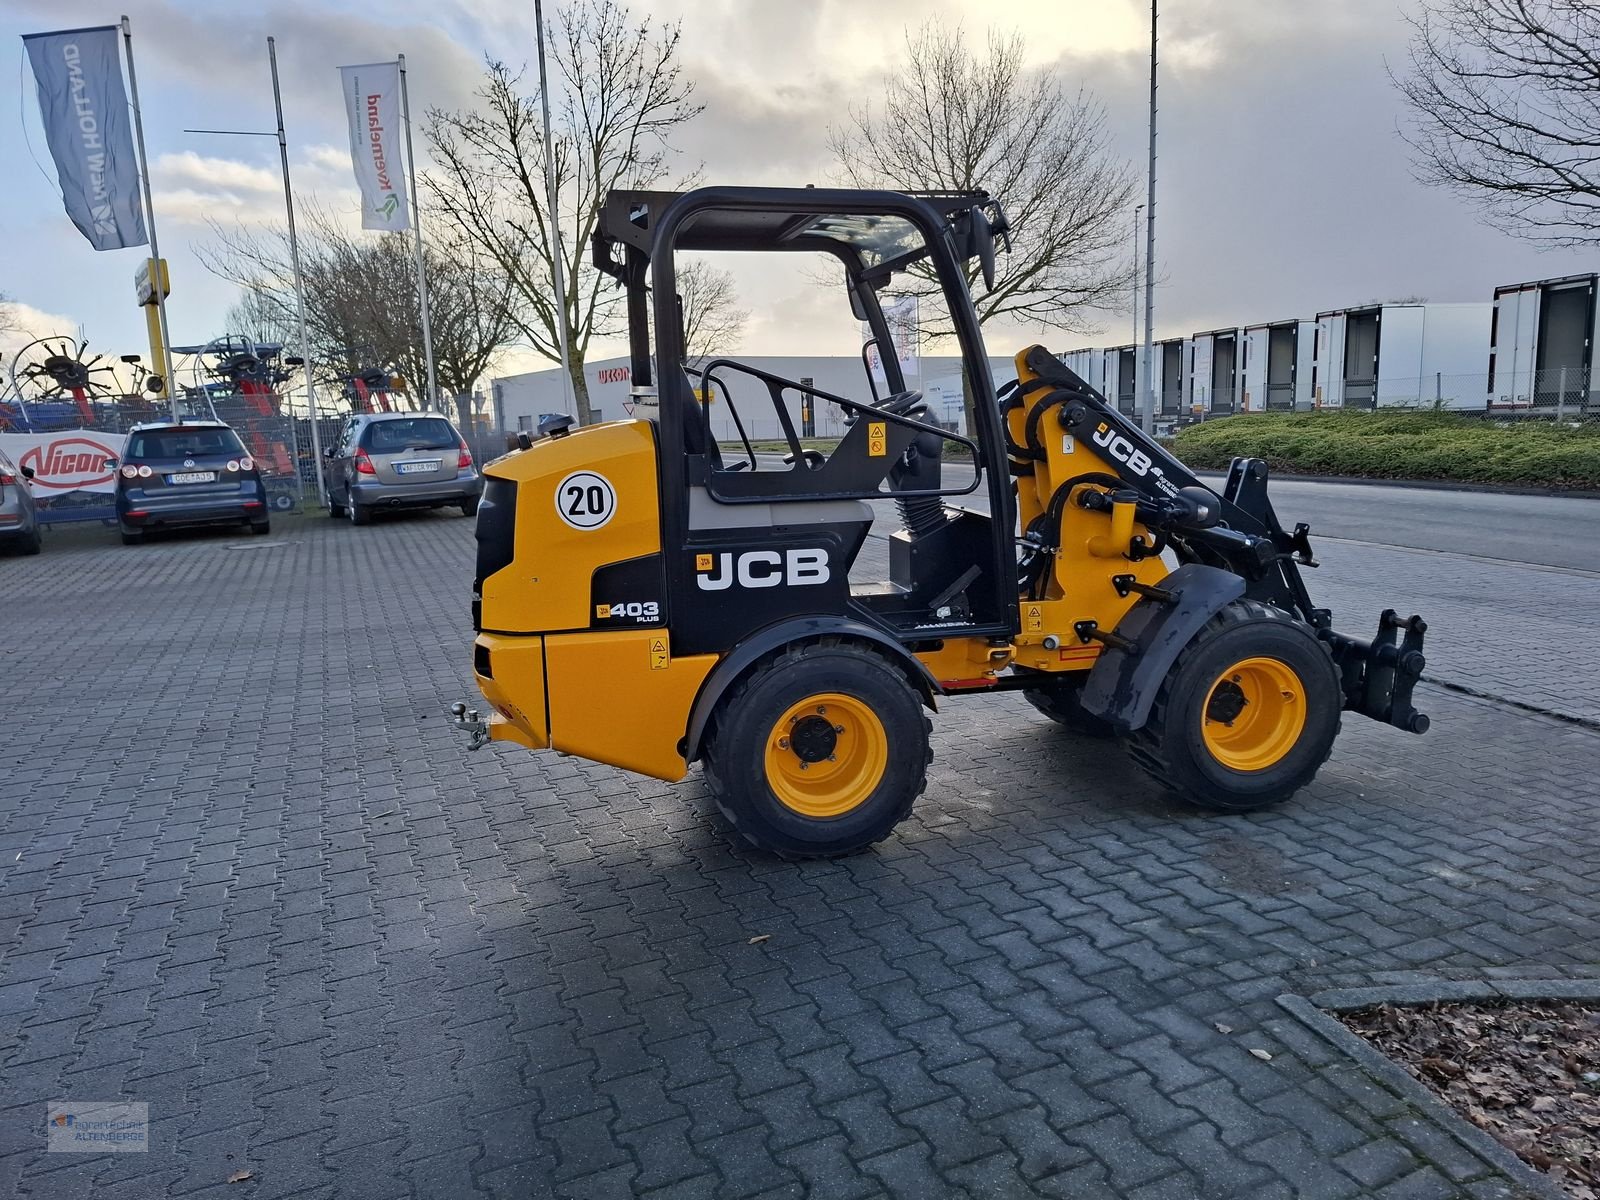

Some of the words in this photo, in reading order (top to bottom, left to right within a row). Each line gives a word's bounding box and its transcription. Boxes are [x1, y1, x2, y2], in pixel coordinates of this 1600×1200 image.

[36, 446, 107, 476] Vicon
[1092, 429, 1152, 476] JCB
[1159, 475, 1180, 493] agrartec
[567, 485, 604, 515] 20
[697, 548, 830, 590] JCB
[610, 601, 659, 617] 403
[637, 615, 659, 623] PLUS
